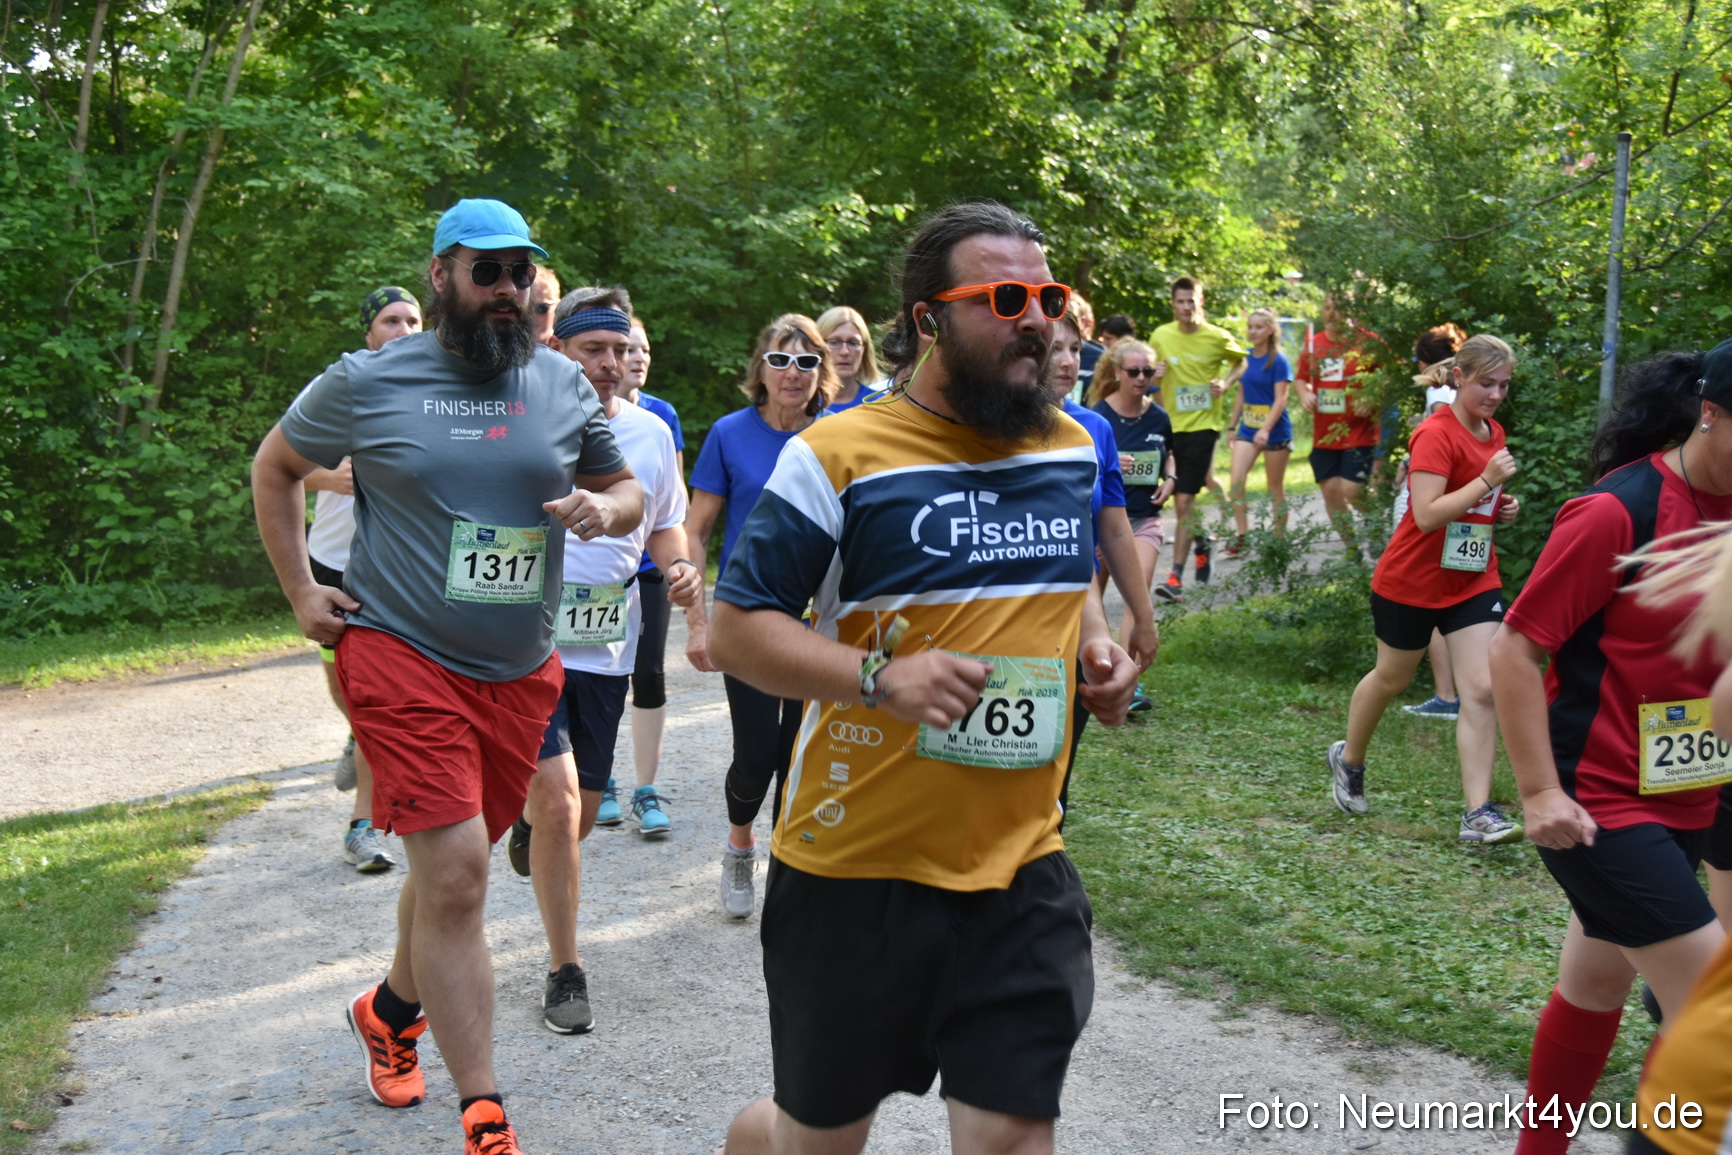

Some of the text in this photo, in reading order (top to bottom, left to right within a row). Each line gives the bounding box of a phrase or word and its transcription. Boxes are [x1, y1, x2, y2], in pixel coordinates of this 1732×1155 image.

[1180, 394, 1207, 405] 1196
[950, 513, 1080, 546] Fischer
[968, 544, 1079, 563] AUTOMOBILE
[1457, 540, 1485, 558] 498
[464, 552, 537, 582] 1317
[475, 581, 496, 590] Raab
[566, 605, 619, 628] 1174
[958, 697, 1035, 737] 763
[828, 743, 850, 754] Audi
[947, 734, 957, 743] M
[992, 738, 1038, 750] Christian
[943, 744, 971, 755] Fischer
[974, 748, 1016, 758] Automobile
[1664, 765, 1702, 777] Seemeier
[1704, 761, 1725, 773] Sonja
[1646, 777, 1676, 785] Trendhaus
